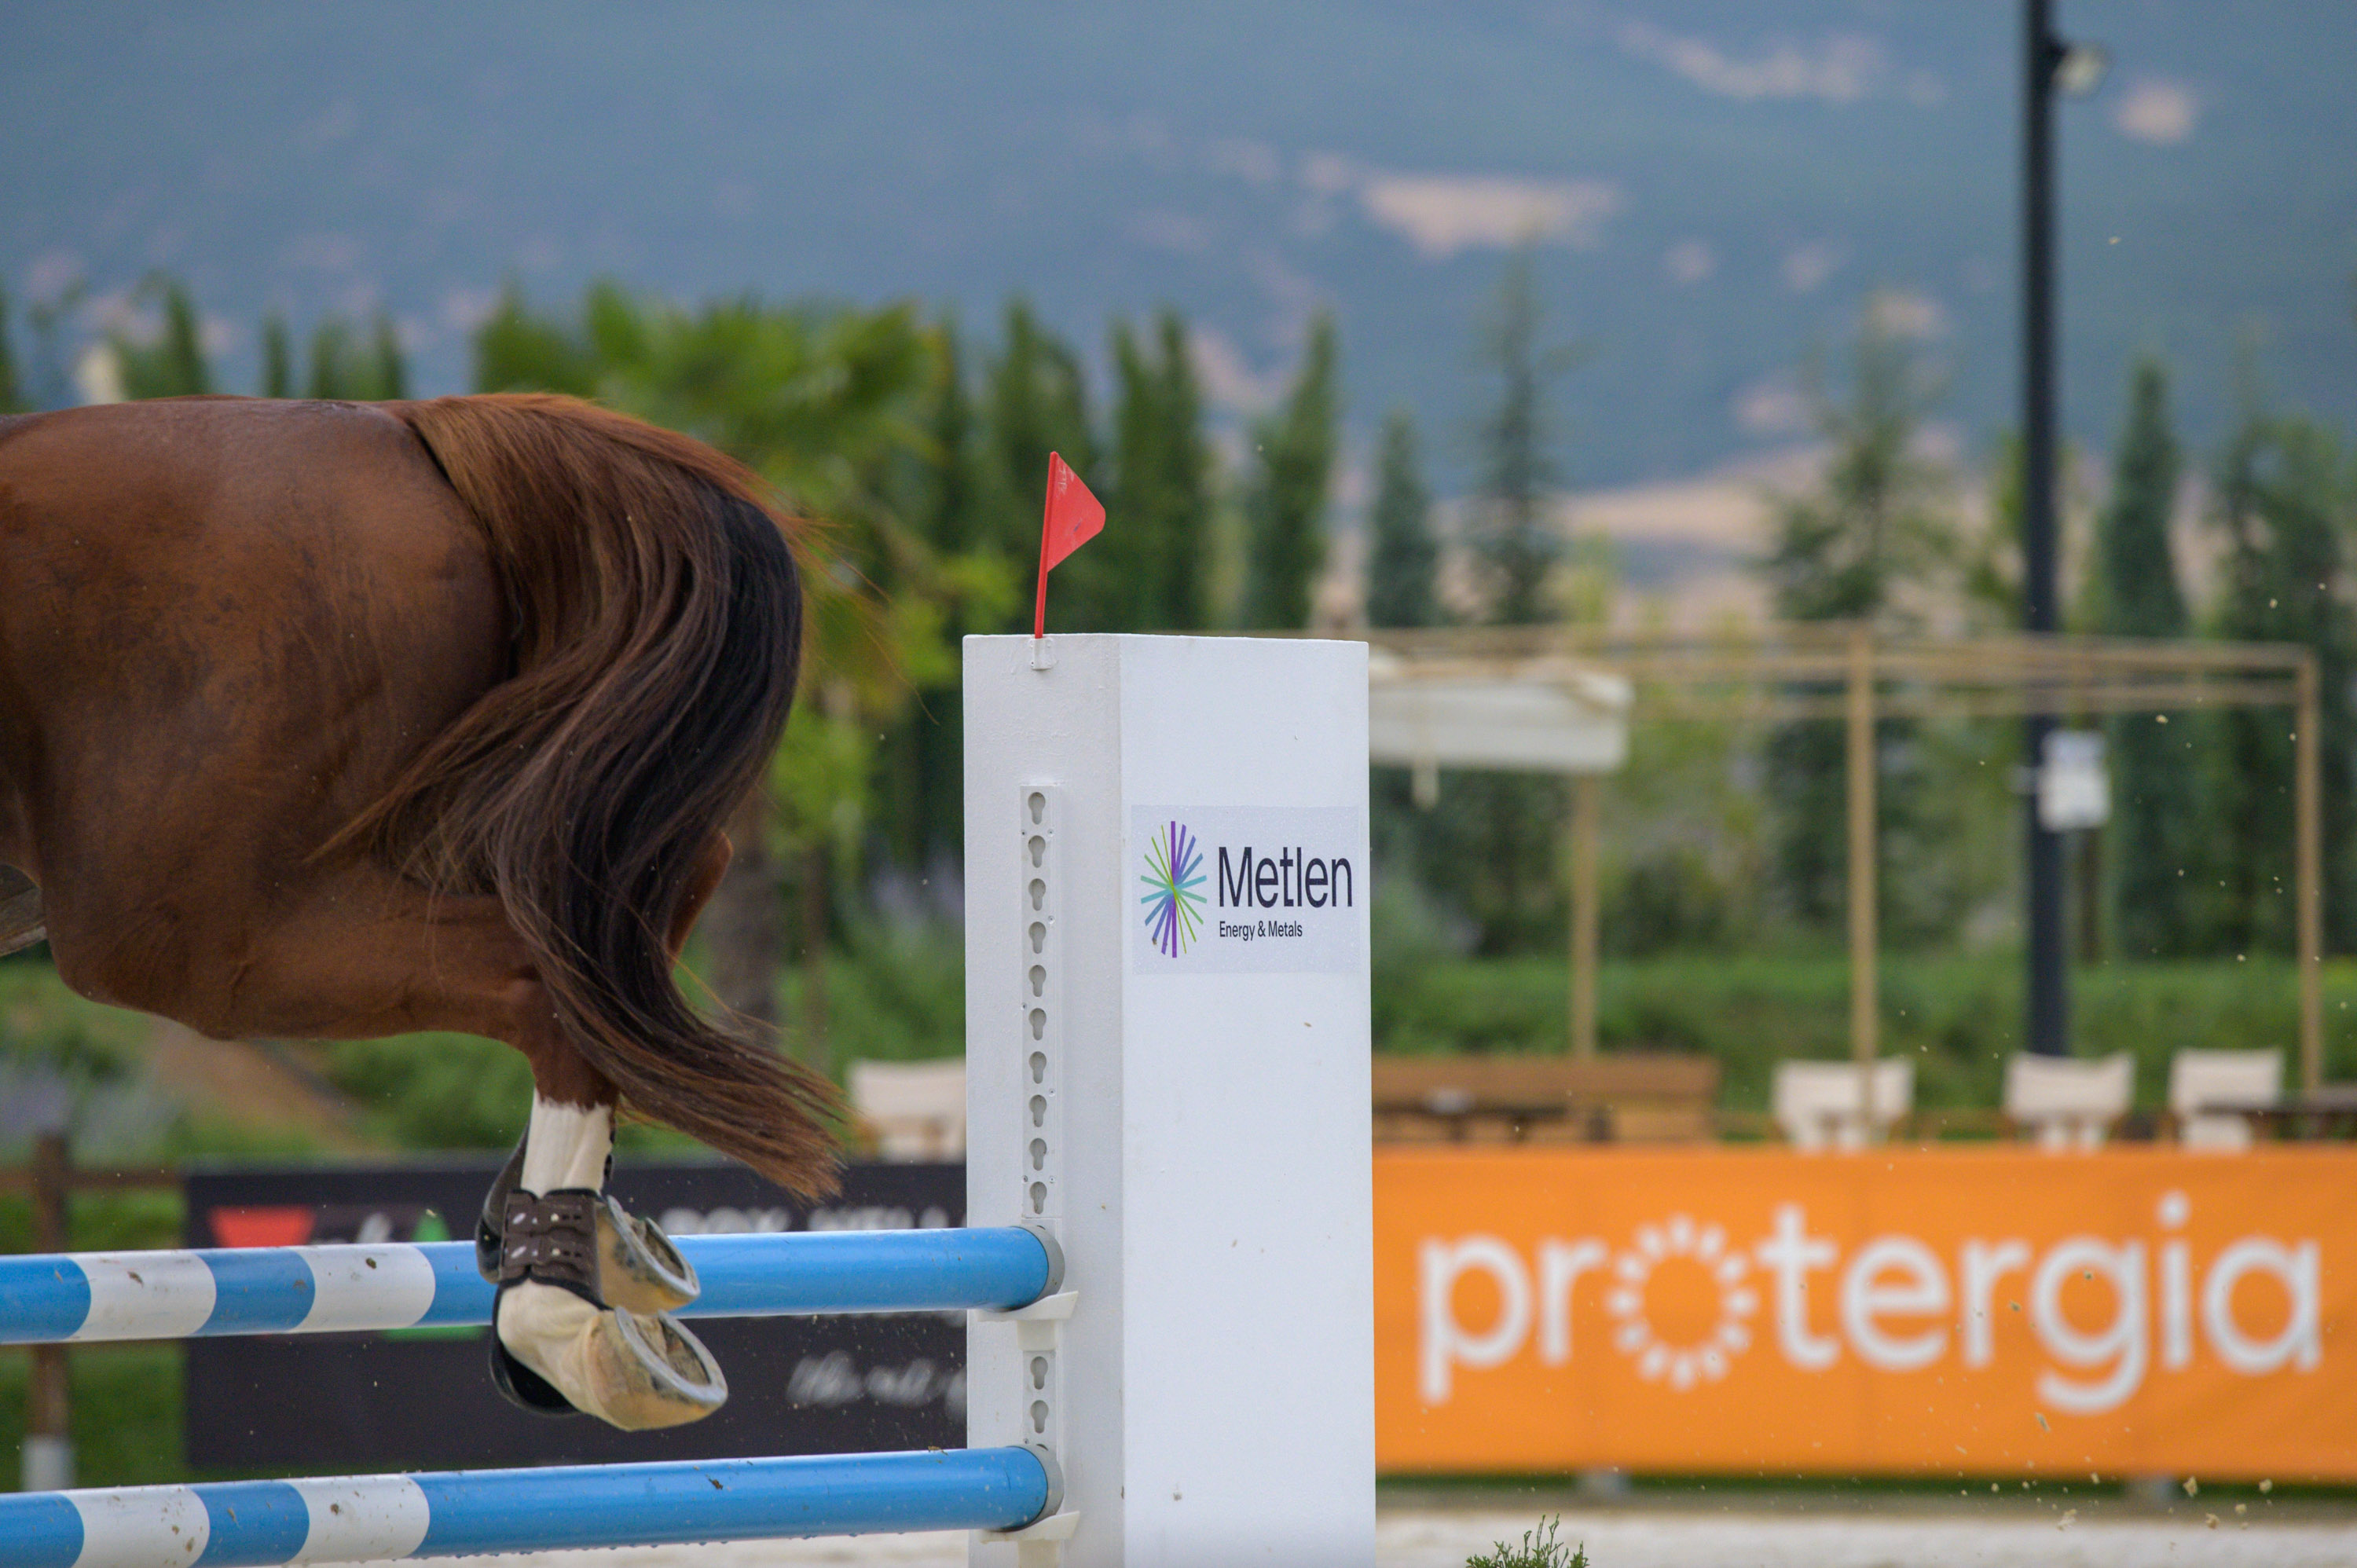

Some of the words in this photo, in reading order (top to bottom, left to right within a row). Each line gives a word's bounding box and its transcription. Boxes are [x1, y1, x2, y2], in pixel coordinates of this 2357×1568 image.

[1219, 846, 1352, 908] Metlen
[1219, 921, 1255, 941] Energy
[1257, 920, 1266, 937] &
[1268, 920, 1303, 937] Metals
[1418, 1190, 2322, 1415] protergia
